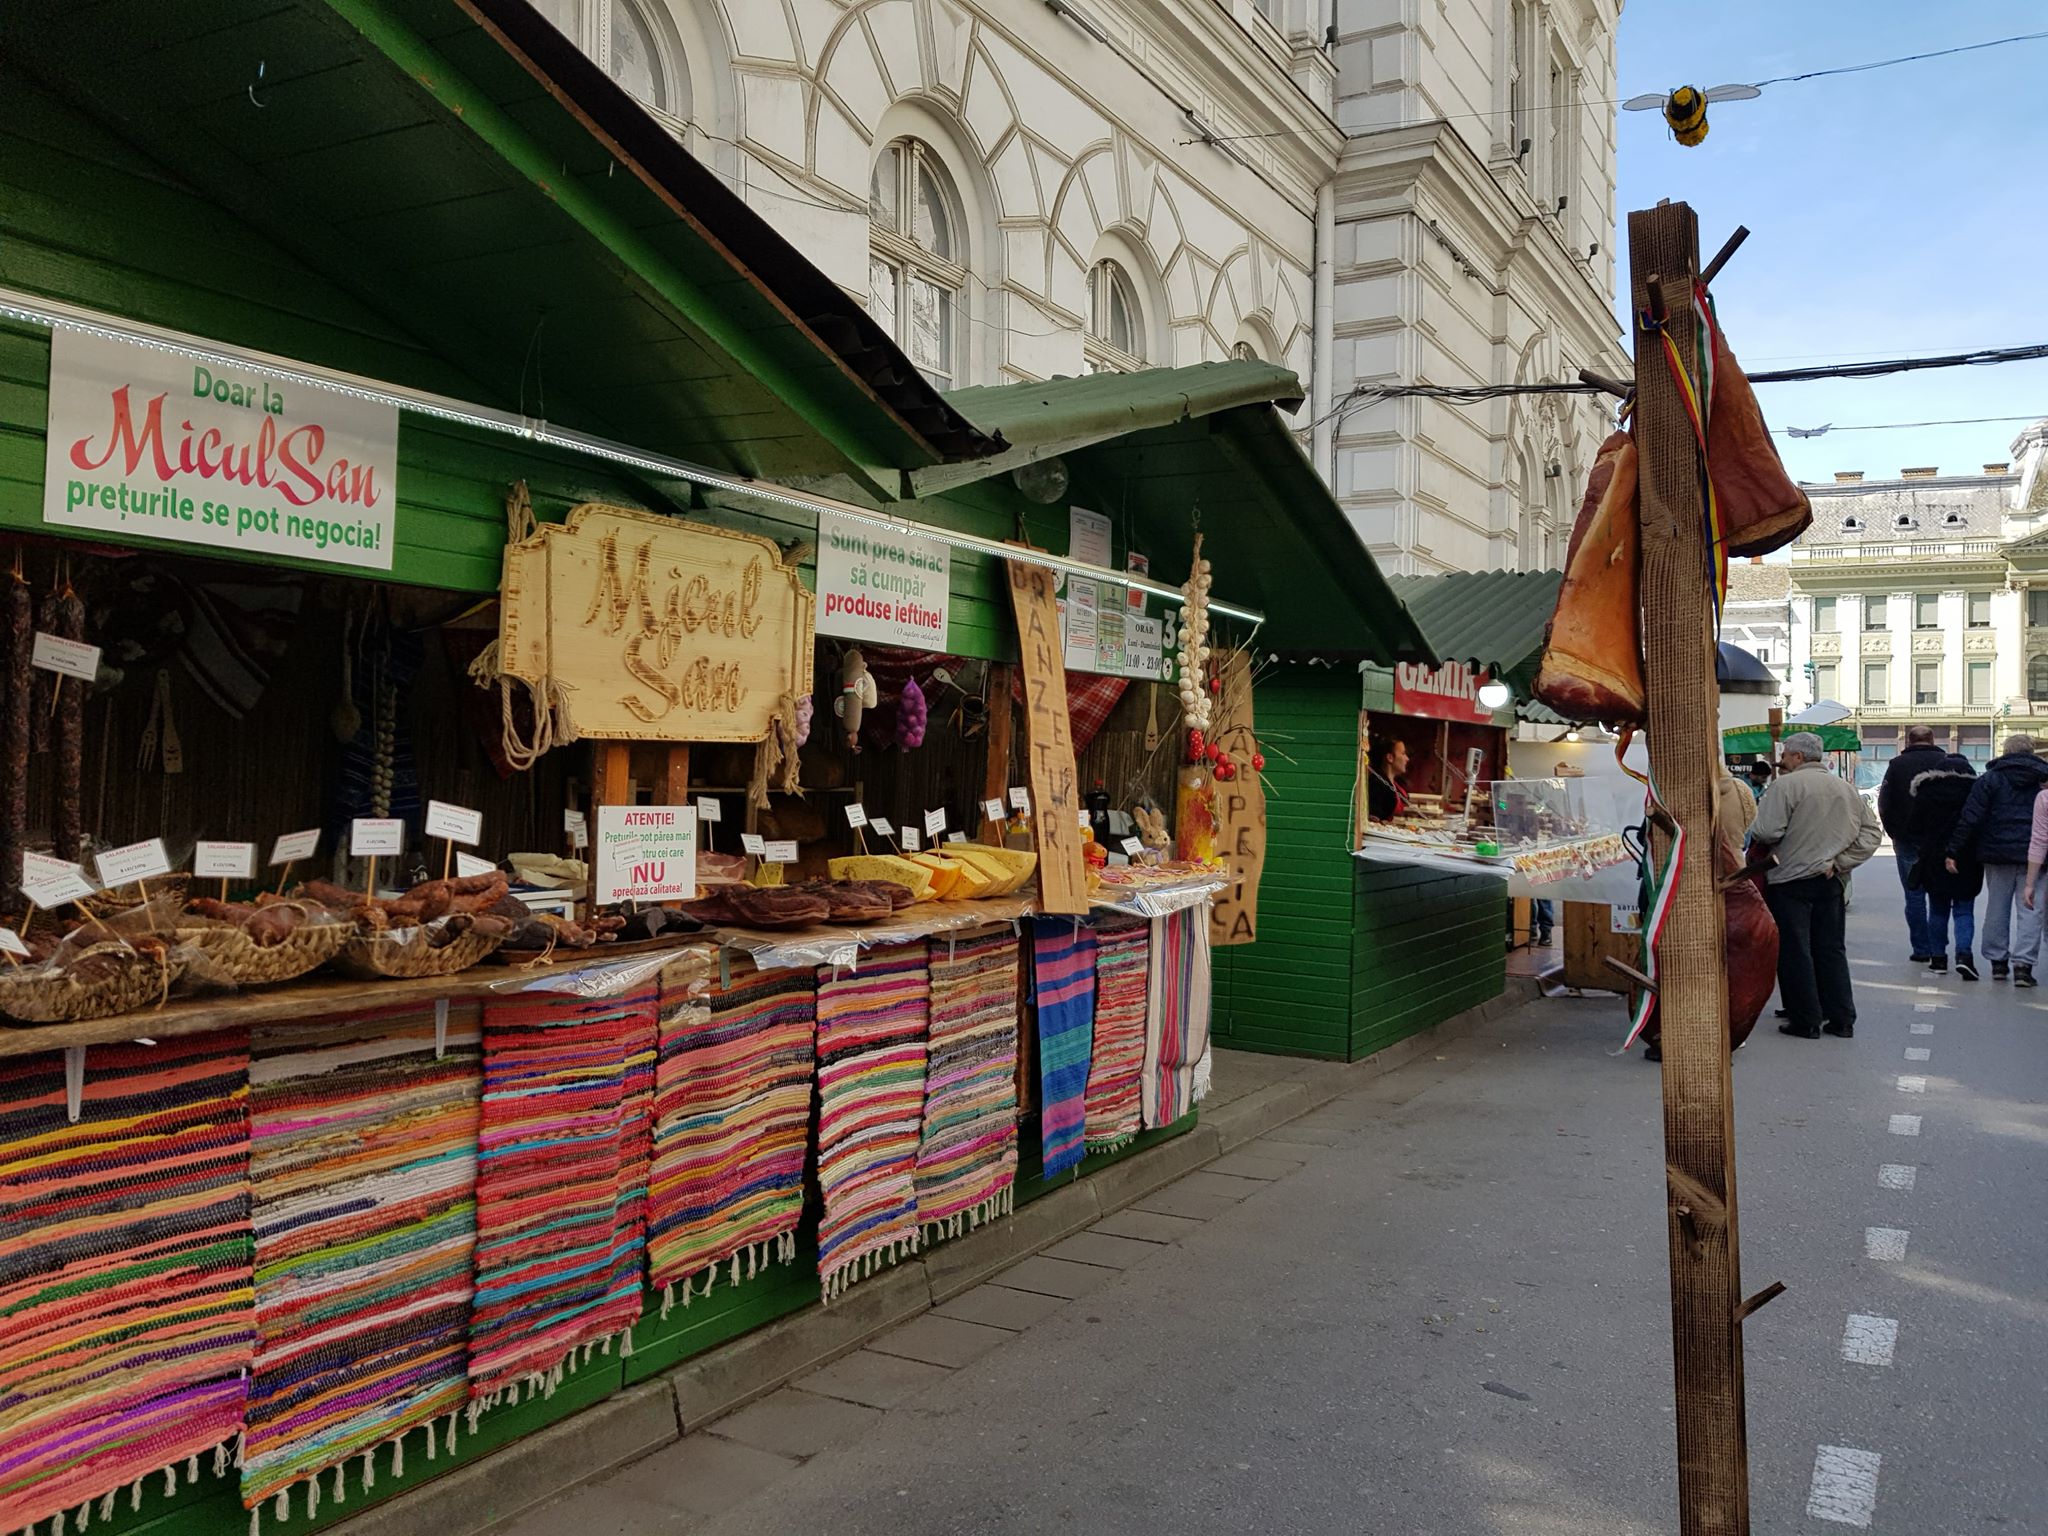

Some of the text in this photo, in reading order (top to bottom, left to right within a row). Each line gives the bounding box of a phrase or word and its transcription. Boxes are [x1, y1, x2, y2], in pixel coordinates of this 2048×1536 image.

[193, 365, 285, 416] Doar la
[66, 480, 381, 550] prețurile se pot negocia!
[829, 525, 944, 573] Sunt prea sărac
[584, 526, 763, 640] Micul
[850, 562, 927, 600] să cumpăr
[825, 592, 943, 630] produse ieftine!
[1135, 623, 1155, 636] ORAR
[616, 620, 748, 722] San
[653, 830, 674, 845] părea
[675, 829, 692, 841] mari
[657, 847, 669, 858] cei
[669, 849, 685, 858] care
[633, 861, 665, 884] NU
[649, 882, 683, 895] calitatea!
